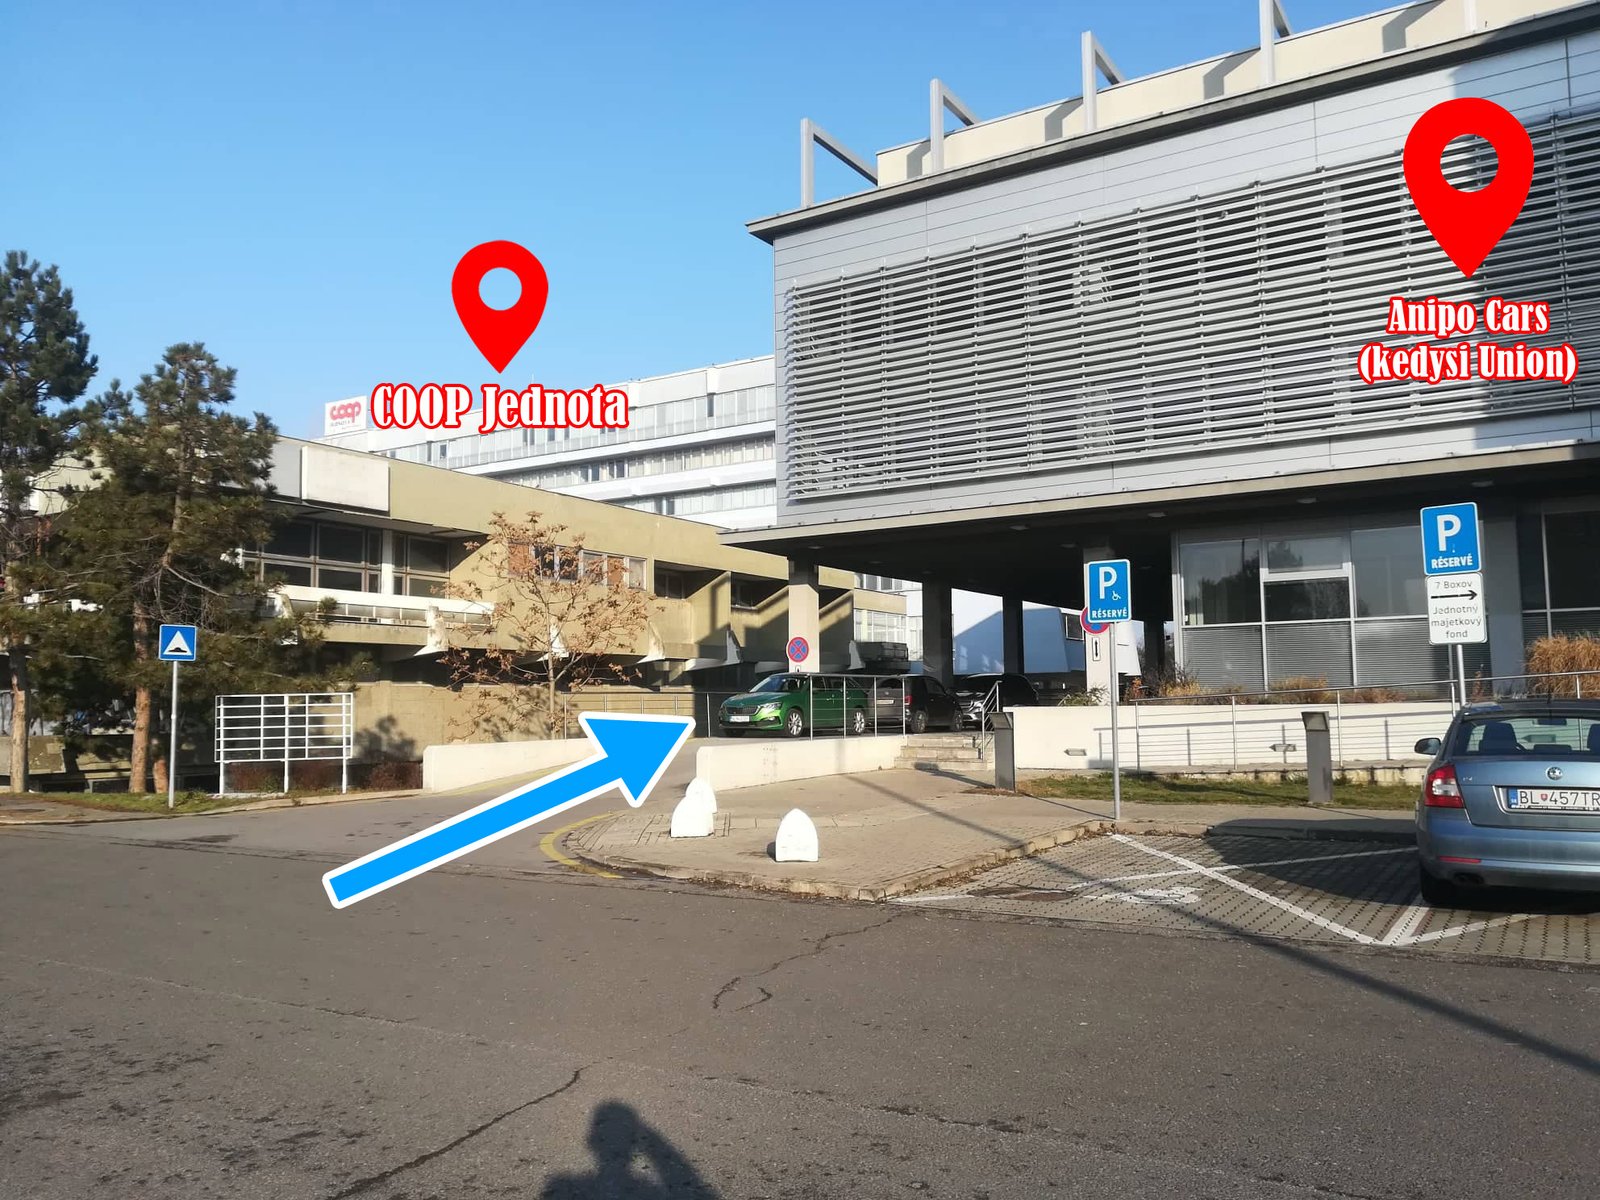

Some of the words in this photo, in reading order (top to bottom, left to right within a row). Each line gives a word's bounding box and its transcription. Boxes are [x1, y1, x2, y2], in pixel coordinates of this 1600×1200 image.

[1437, 514, 1461, 552] P
[1431, 553, 1473, 569] RÉSERVÉ
[1099, 566, 1117, 599] P
[1443, 581, 1473, 589] Boxov
[1092, 606, 1127, 618] RÉSERVÉ
[1433, 603, 1478, 615] Jednotný
[1431, 616, 1481, 628] majetkový
[1446, 630, 1468, 638] fond
[1520, 791, 1539, 804] BL
